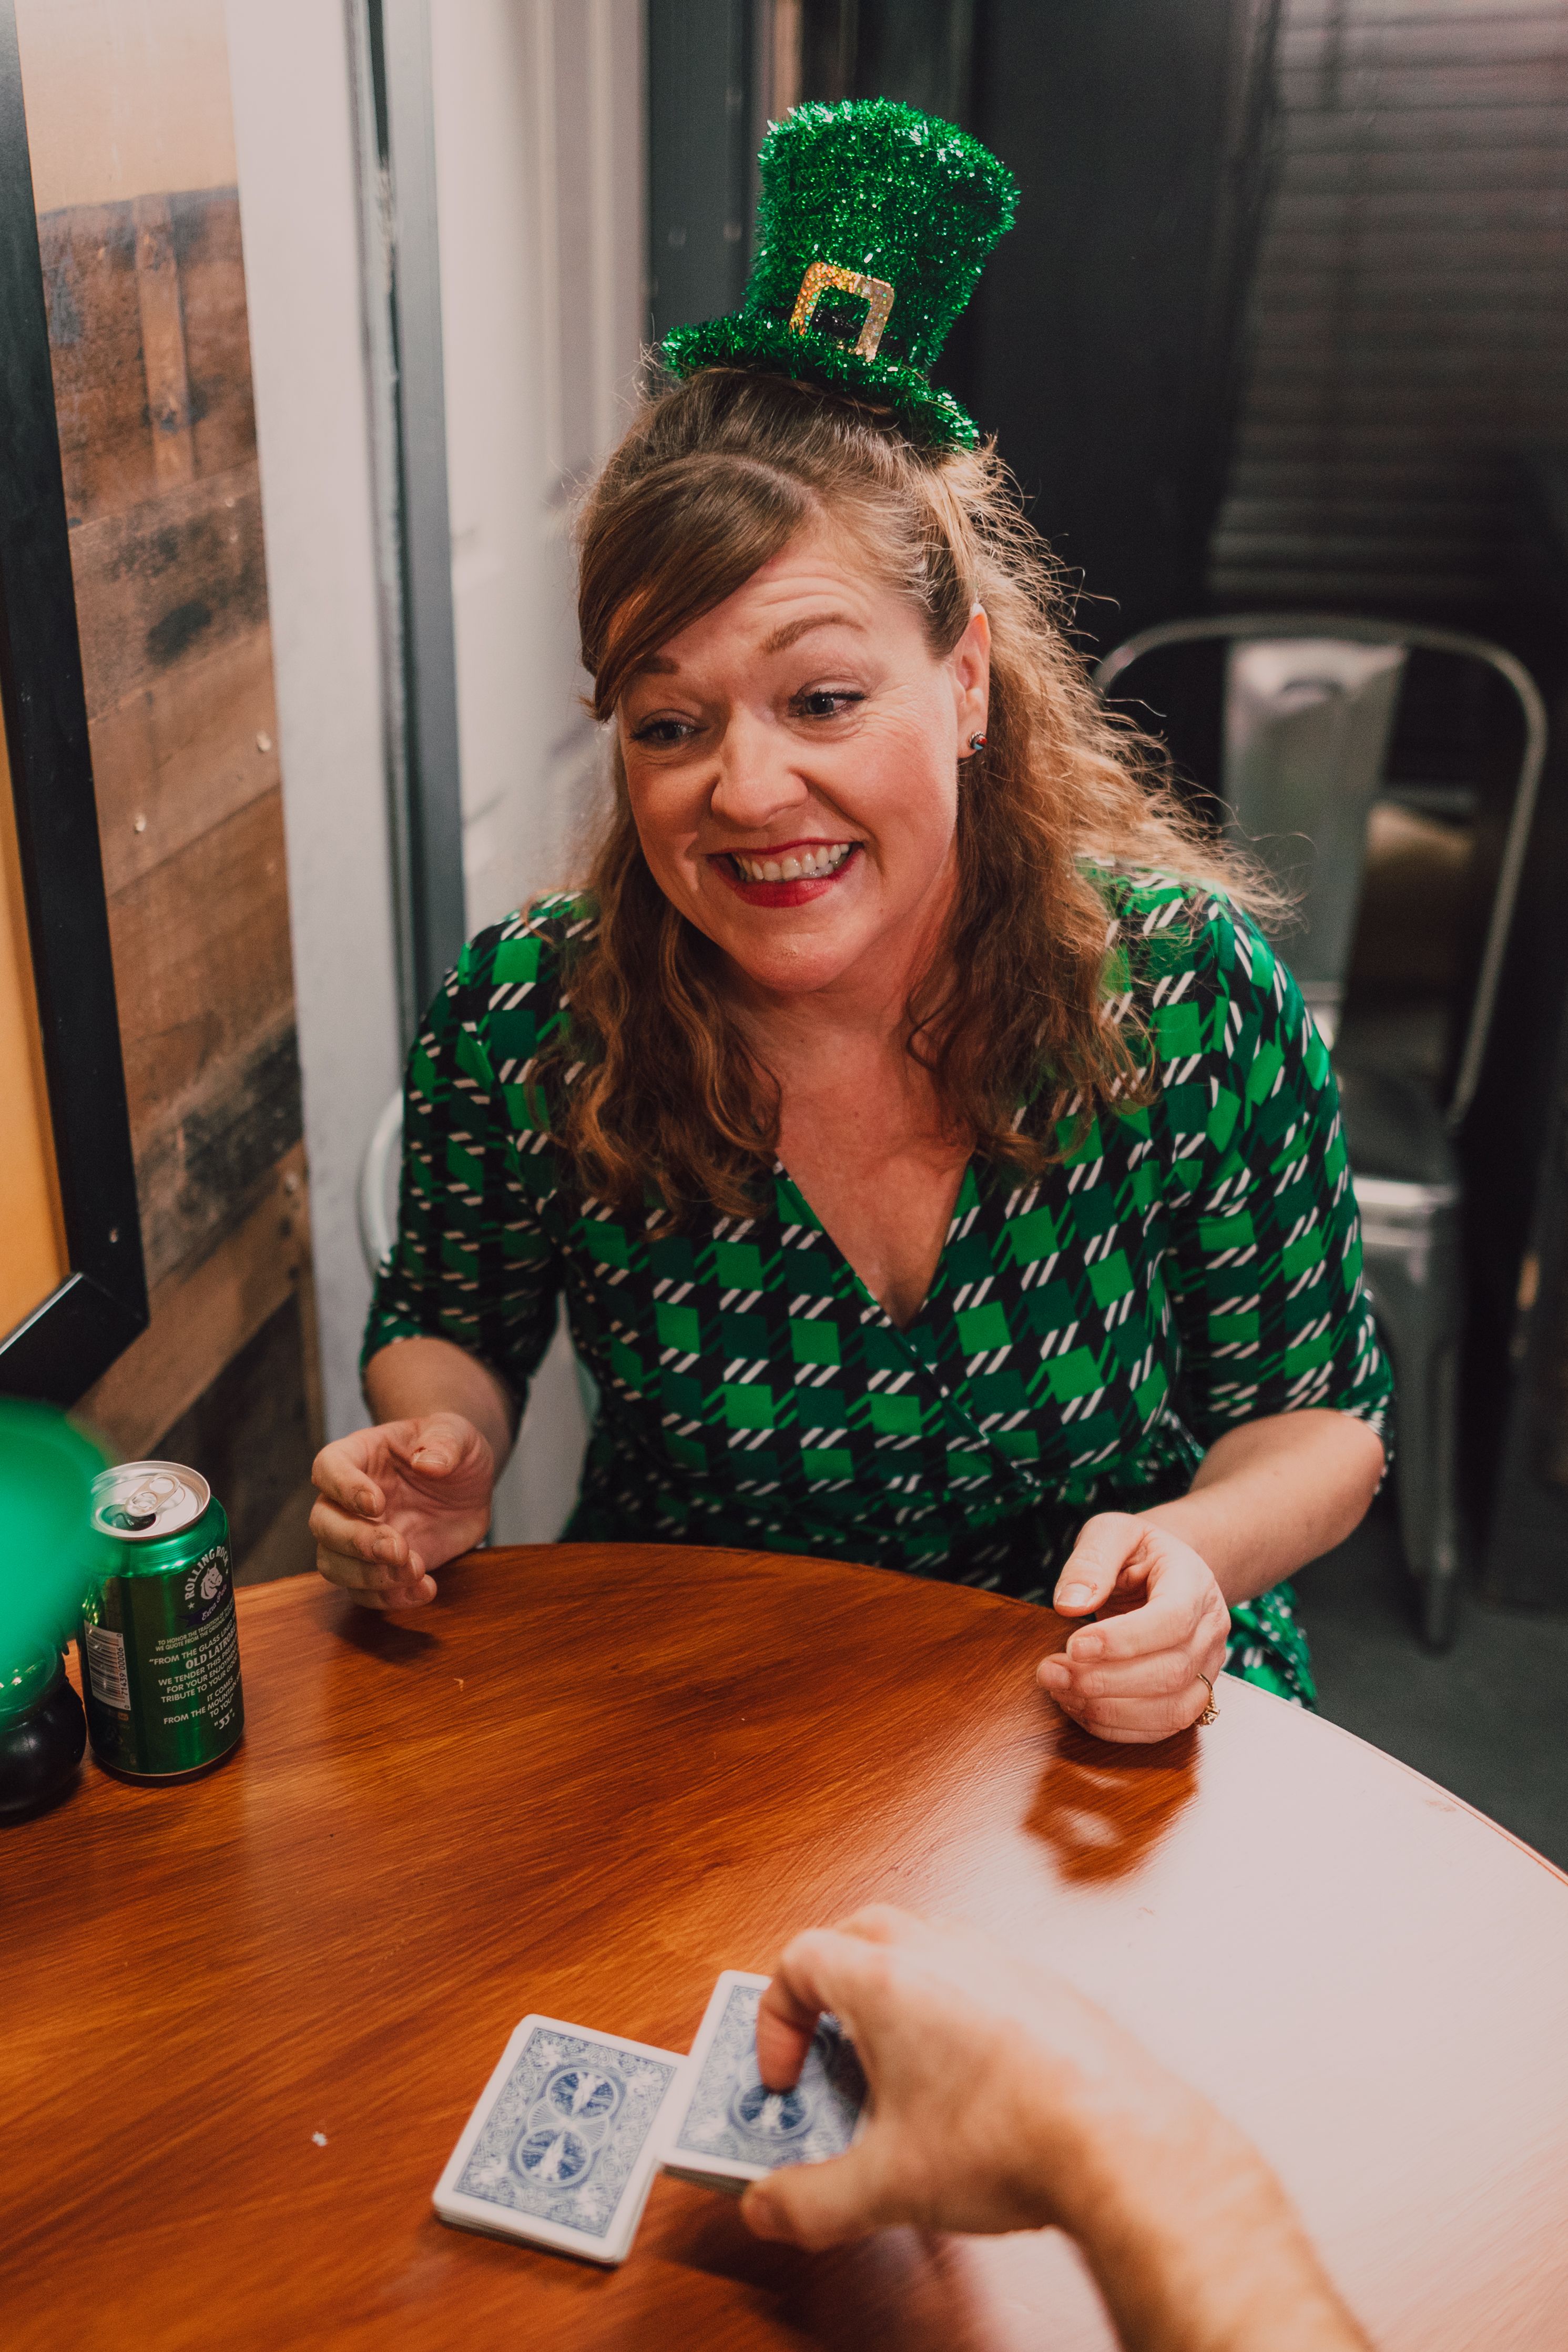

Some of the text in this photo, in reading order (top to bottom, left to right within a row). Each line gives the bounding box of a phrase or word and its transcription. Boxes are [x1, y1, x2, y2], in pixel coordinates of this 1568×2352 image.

[185, 1546, 229, 1600] ROLLING ROCK
[202, 1603, 217, 1621] Extra
[167, 1634, 187, 1644] HONOR
[198, 1617, 219, 1633] TRADITION
[165, 1641, 184, 1650] QUOTE
[185, 1635, 199, 1644] FROM
[181, 1648, 197, 1658] THE
[199, 1635, 220, 1652] GLASS
[117, 1647, 125, 1671] 00006
[175, 1666, 205, 1683] TENDER
[207, 1657, 221, 1670] THIS
[186, 1654, 207, 1669] OLD
[119, 1673, 128, 1696] 71439
[161, 1689, 195, 1703] TRIBUTE
[197, 1684, 207, 1693] TO
[209, 1670, 226, 1687] YOUR
[167, 1684, 184, 1693] FOR
[186, 1674, 208, 1688] YOUR
[207, 1693, 213, 1702] IT
[215, 1675, 233, 1697] COMES
[164, 1681, 237, 1725] FROM THE MOUNTAIN
[210, 1708, 219, 1718] TO
